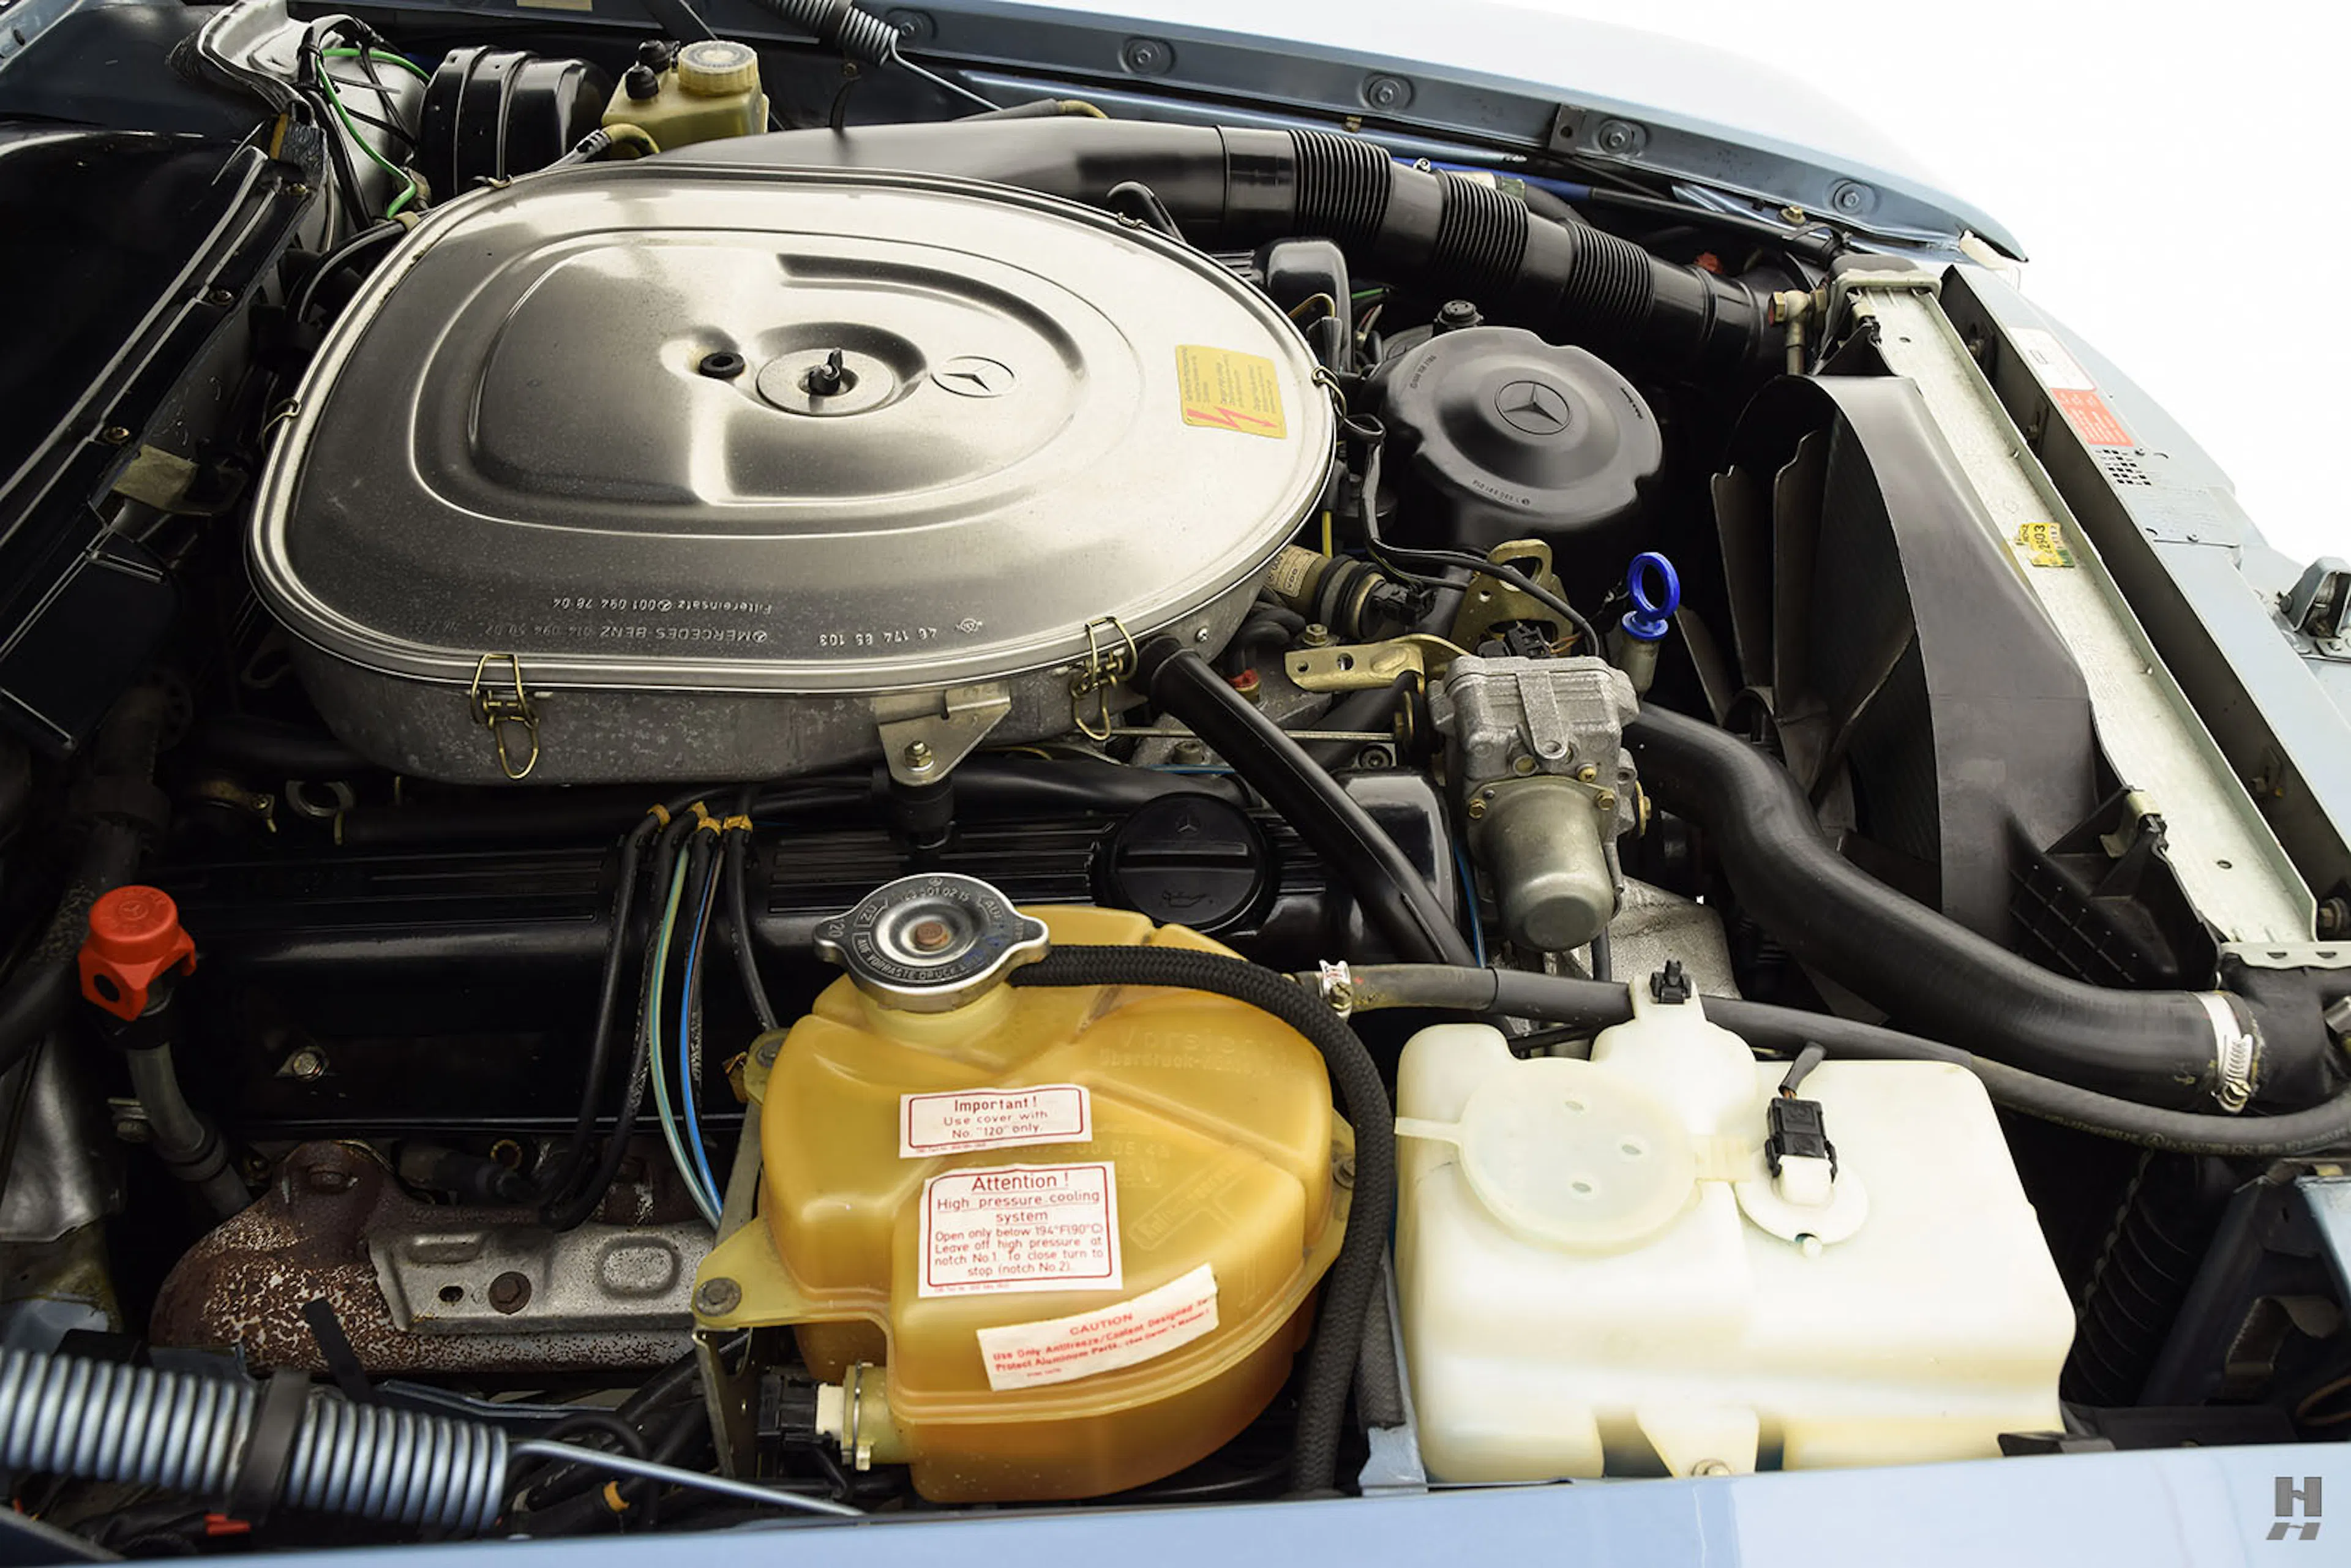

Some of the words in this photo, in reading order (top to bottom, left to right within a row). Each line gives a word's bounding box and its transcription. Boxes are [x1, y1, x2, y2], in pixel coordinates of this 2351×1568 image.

[677, 599, 772, 615] Filtereinsatz
[943, 1116, 971, 1127] Use
[977, 1114, 1012, 1124] cover
[1019, 1110, 1048, 1120] with
[972, 1174, 1057, 1191] Attention
[937, 1198, 969, 1212] High
[979, 1196, 1042, 1209] pressure
[1049, 1191, 1100, 1204] cooling
[996, 1210, 1048, 1225] system
[935, 1230, 964, 1242] Open
[968, 1227, 993, 1239] only
[996, 1226, 1031, 1237] below
[935, 1243, 970, 1254] Leave
[974, 1240, 990, 1250] off
[997, 1239, 1022, 1252] high
[1029, 1237, 1081, 1250] pressure
[1090, 1236, 1102, 1245] at
[934, 1255, 967, 1266] notch
[1008, 1251, 1021, 1261] To
[1027, 1248, 1057, 1260] close
[1063, 1248, 1087, 1259] turn
[1092, 1248, 1104, 1258] to
[967, 1265, 993, 1277] stop
[998, 1263, 1035, 1275] (notch
[1069, 1312, 1133, 1336] CAUTION
[992, 1352, 1013, 1361] Use
[1016, 1349, 1041, 1358] Only
[1148, 1305, 1193, 1327] Designed
[995, 1359, 1032, 1371] Protect
[1035, 1351, 1089, 1365] Aluminum
